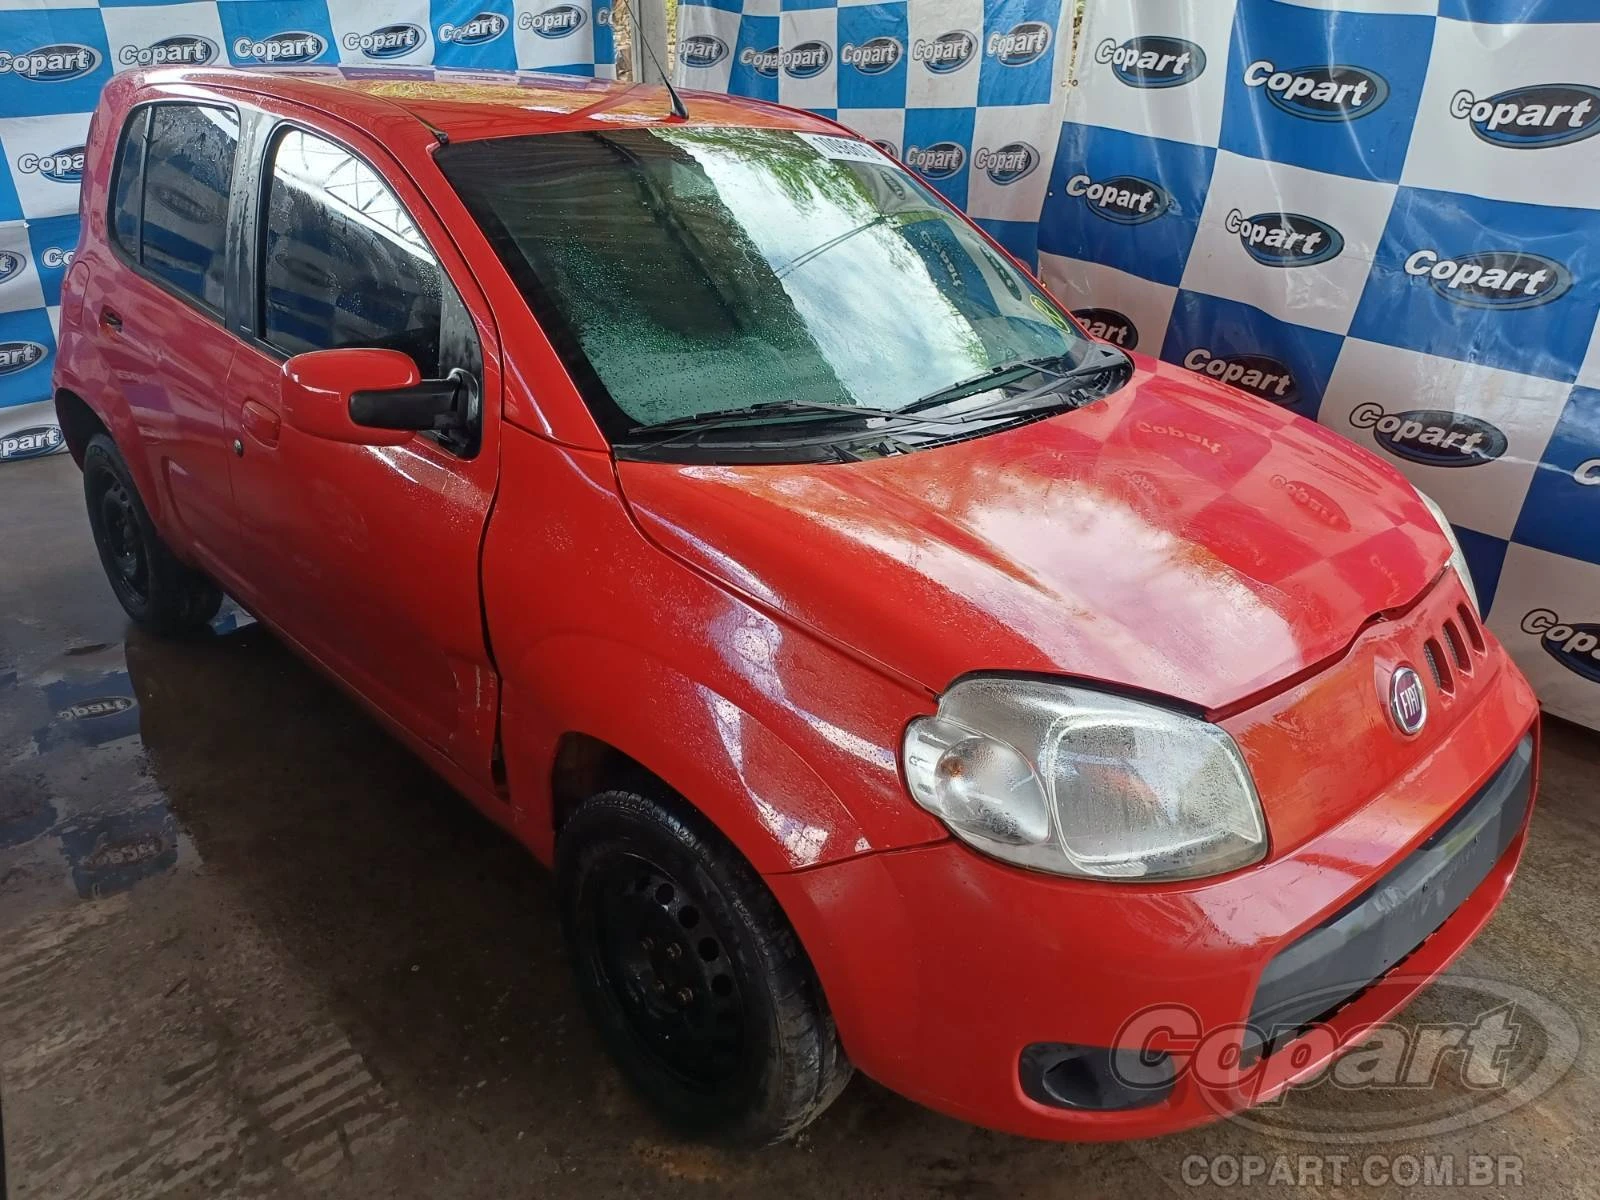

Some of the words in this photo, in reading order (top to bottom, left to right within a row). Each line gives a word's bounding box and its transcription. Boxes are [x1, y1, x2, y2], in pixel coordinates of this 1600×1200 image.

[518, 6, 579, 31] Copart
[119, 40, 206, 65] Copart
[234, 34, 319, 63] Copart
[342, 27, 415, 51] Copart
[679, 41, 719, 60] opart
[912, 32, 970, 67] Copart
[986, 26, 1047, 61] Copart
[0, 50, 90, 76] Copart
[740, 48, 778, 71] Copa
[840, 39, 898, 70] Copart
[1095, 37, 1192, 74] Copart
[1243, 61, 1369, 107] Copart
[1450, 89, 1592, 130] Copart
[18, 152, 84, 176] Copa
[906, 146, 962, 173] Copart
[975, 147, 1028, 172] Copart
[1065, 175, 1155, 213] Copart
[1225, 208, 1321, 255] Copart
[1404, 249, 1561, 297] Copart
[1077, 317, 1128, 345] part
[0, 344, 34, 365] art
[1183, 348, 1291, 398] Copart
[0, 427, 59, 457] part
[1349, 402, 1485, 455] Copart
[1521, 608, 1600, 657] Cop
[1400, 684, 1420, 719] FIAT
